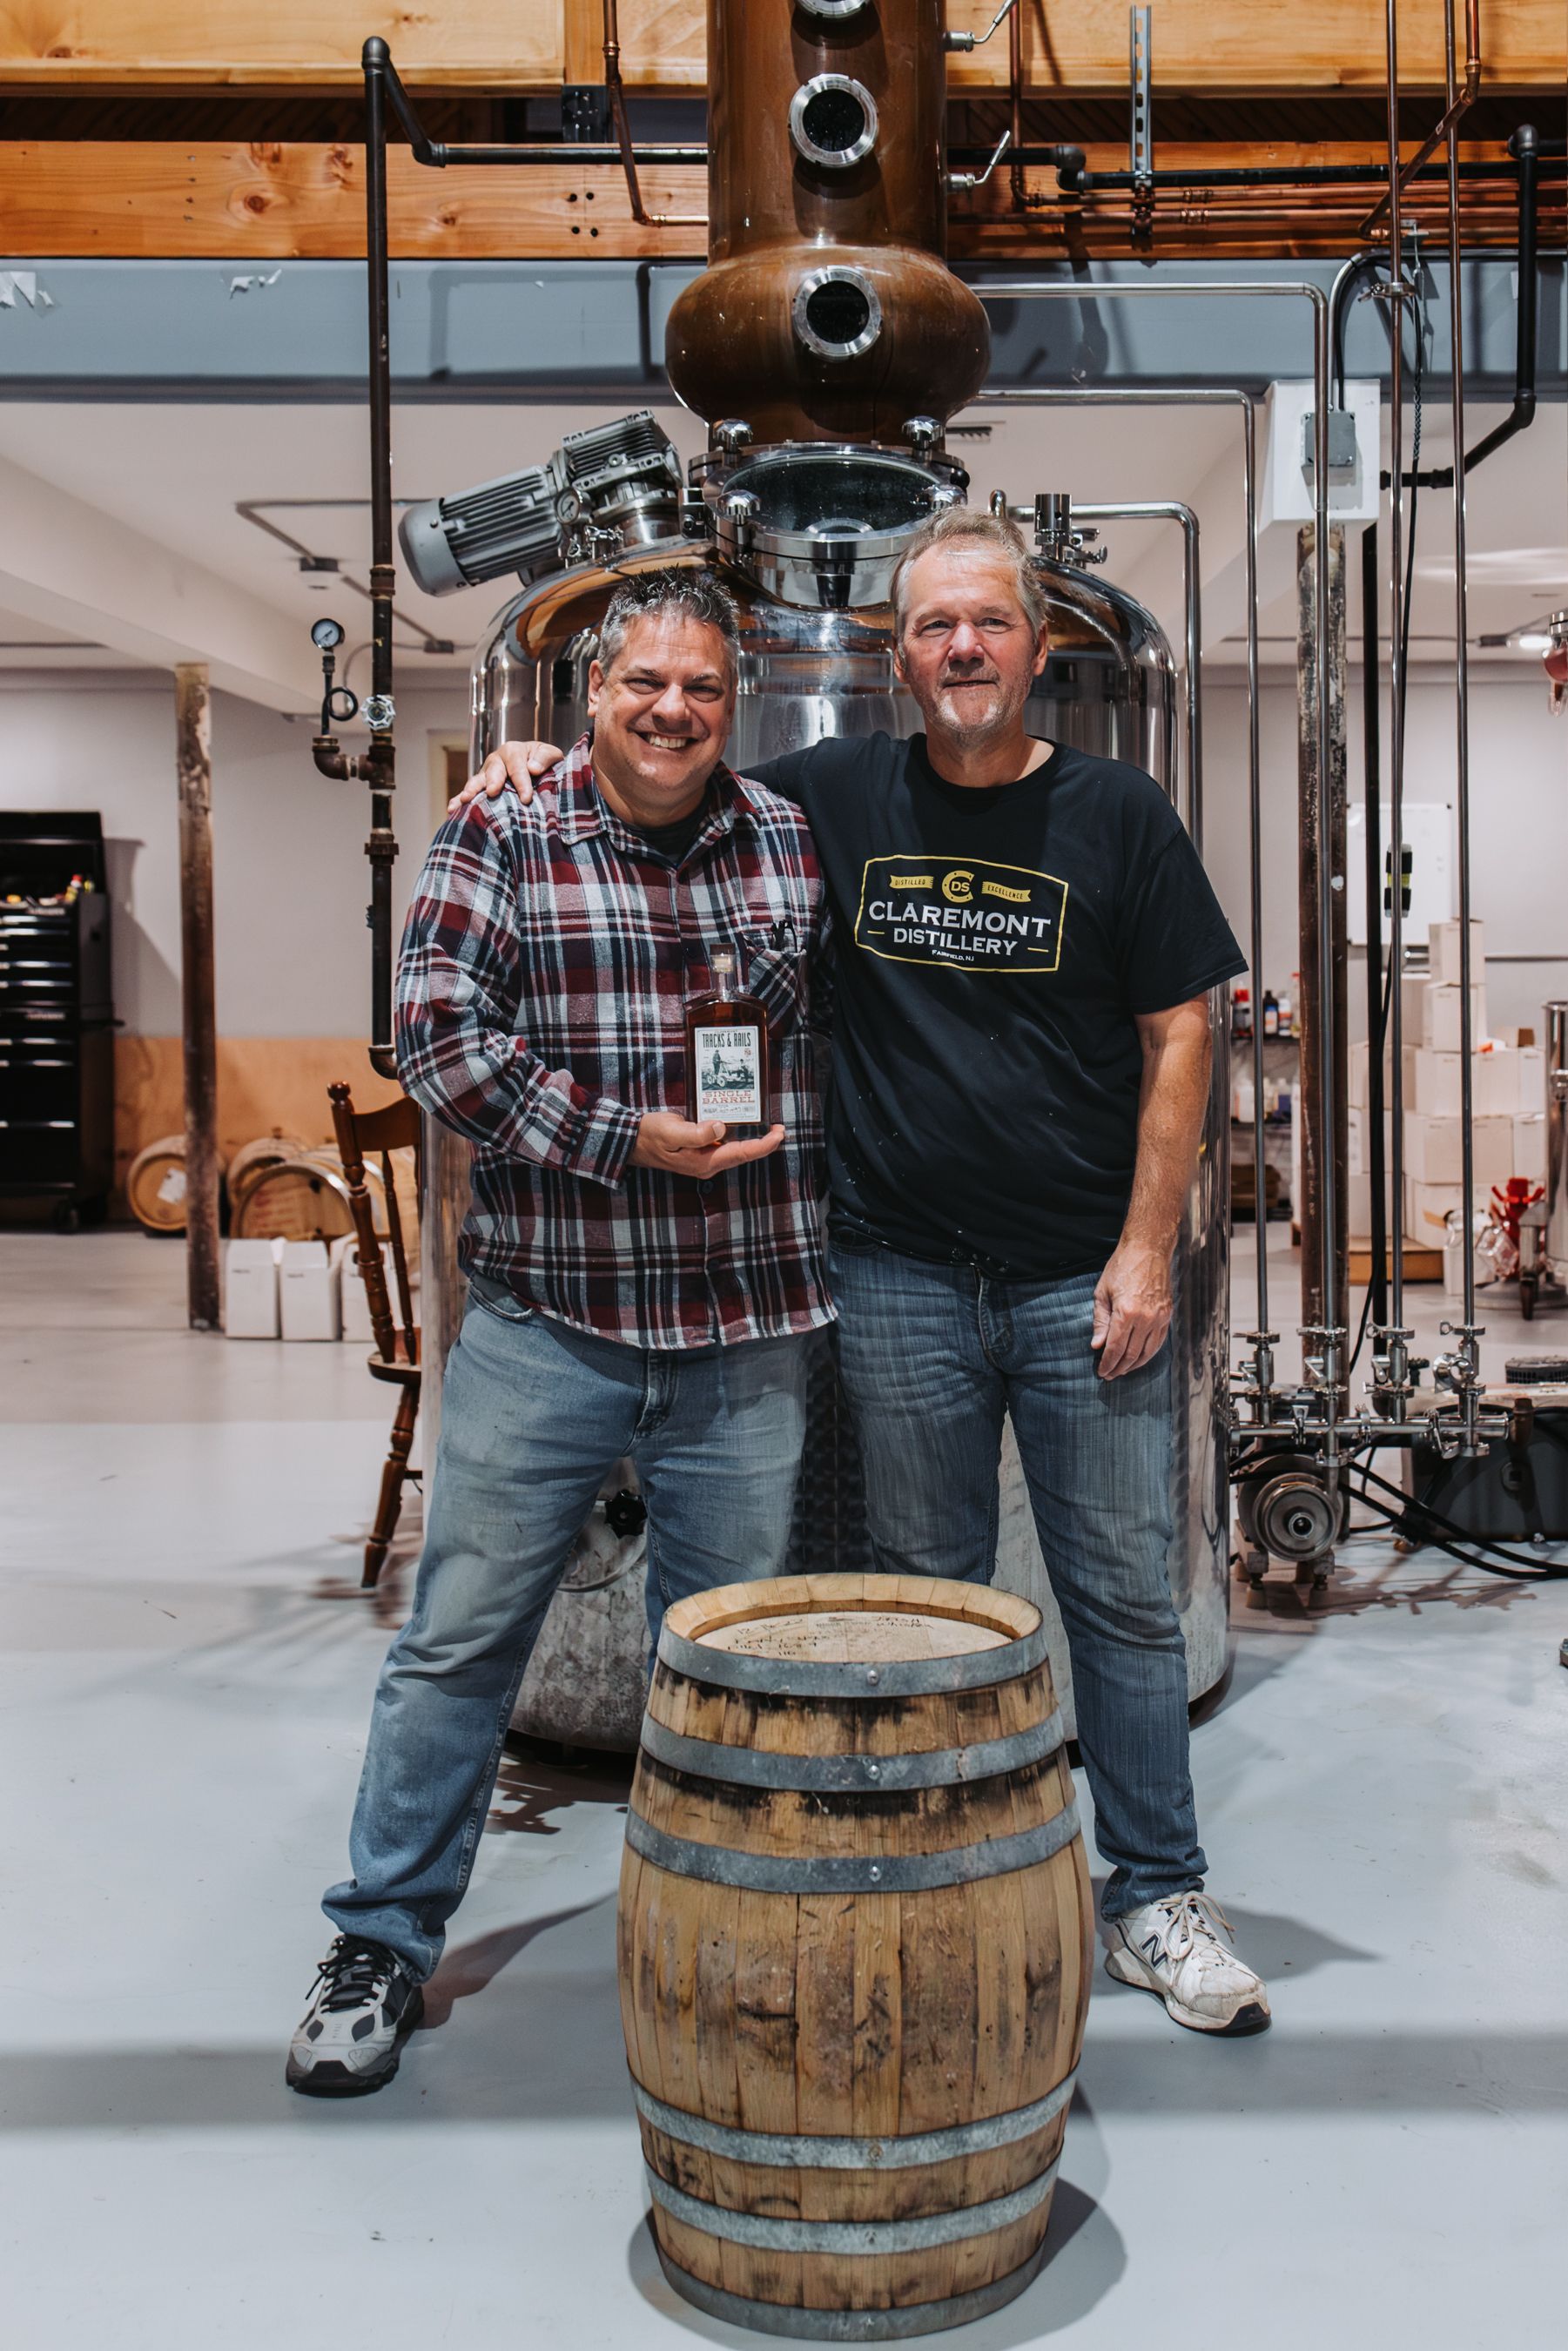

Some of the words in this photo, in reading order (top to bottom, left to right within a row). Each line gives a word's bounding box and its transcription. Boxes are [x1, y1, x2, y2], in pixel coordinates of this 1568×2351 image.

[894, 878, 925, 886] DISTILLED
[986, 885, 1024, 900] EXCELLENCE
[869, 900, 1052, 938] CLAREMONT
[893, 927, 1019, 956] DISTILLERY
[703, 1033, 725, 1048] TRACKS
[727, 1033, 732, 1048] &
[733, 1032, 751, 1048] RAILS
[702, 1096, 755, 1105] BARREL
